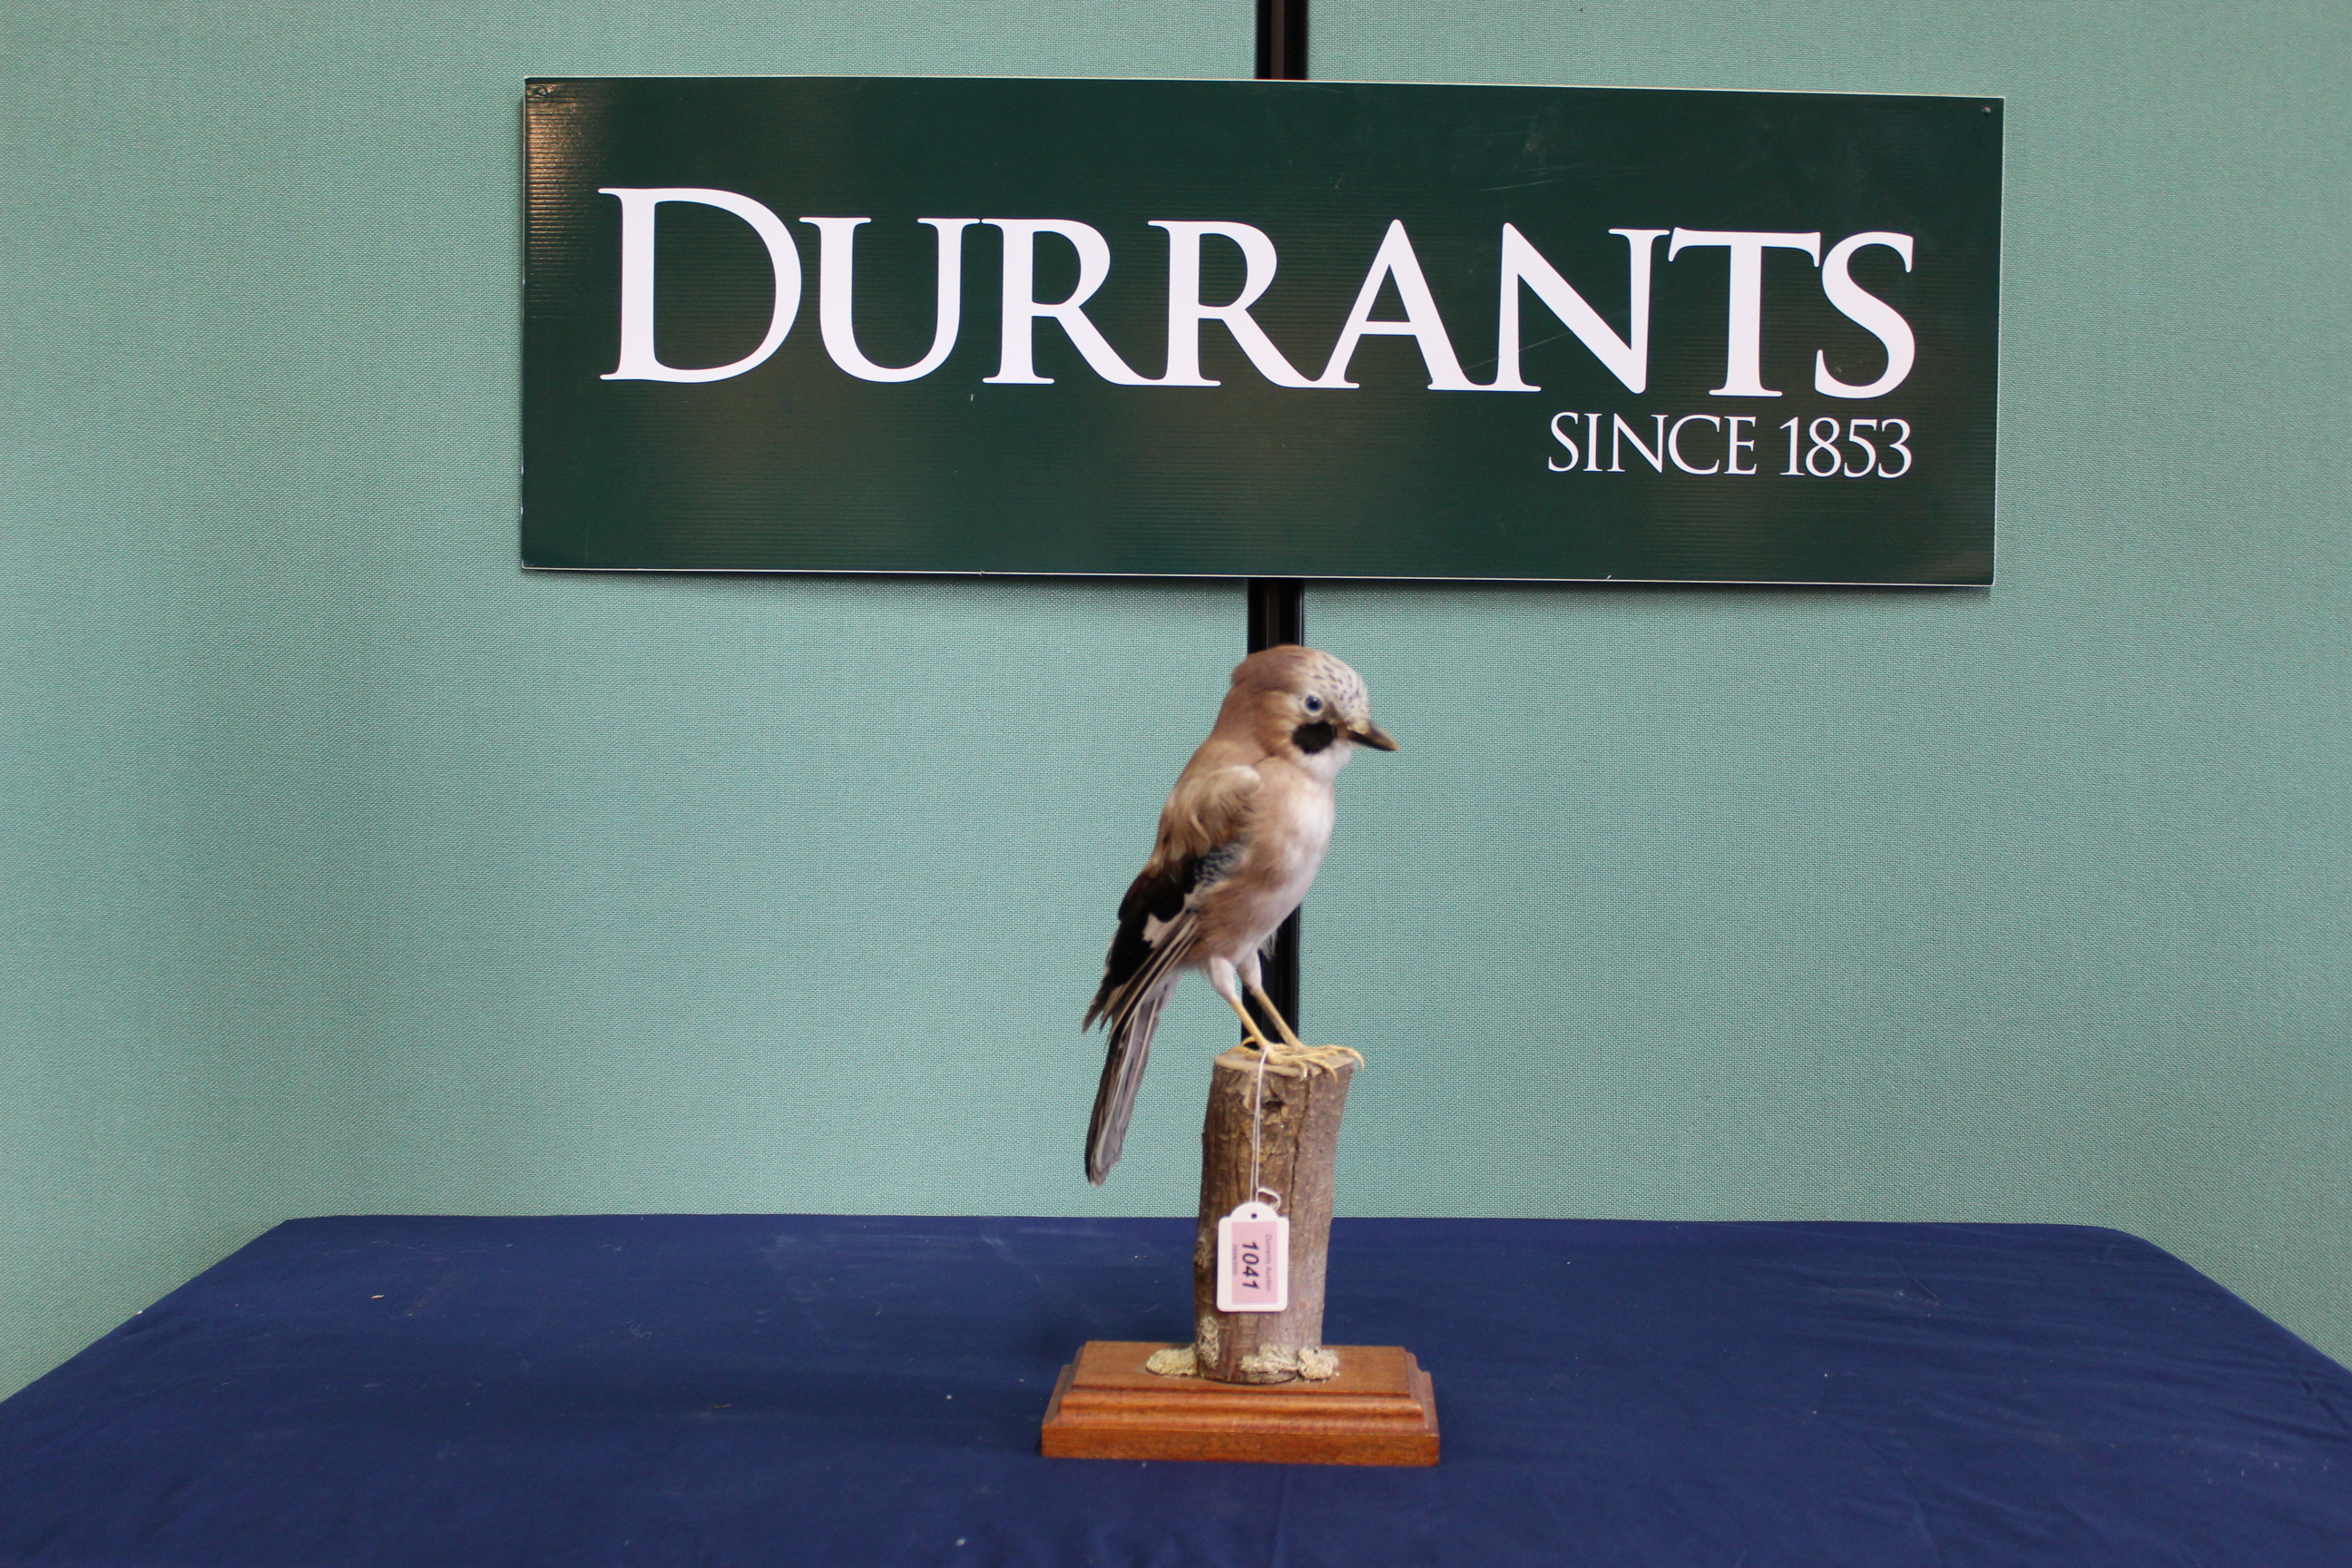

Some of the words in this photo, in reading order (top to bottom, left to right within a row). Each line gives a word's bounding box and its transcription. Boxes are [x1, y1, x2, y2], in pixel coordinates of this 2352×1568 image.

[597, 187, 1916, 399] DURRANTS
[1547, 411, 1758, 477] SINCE
[1779, 416, 1913, 479] 1853
[1241, 1241, 1259, 1290] 1041
